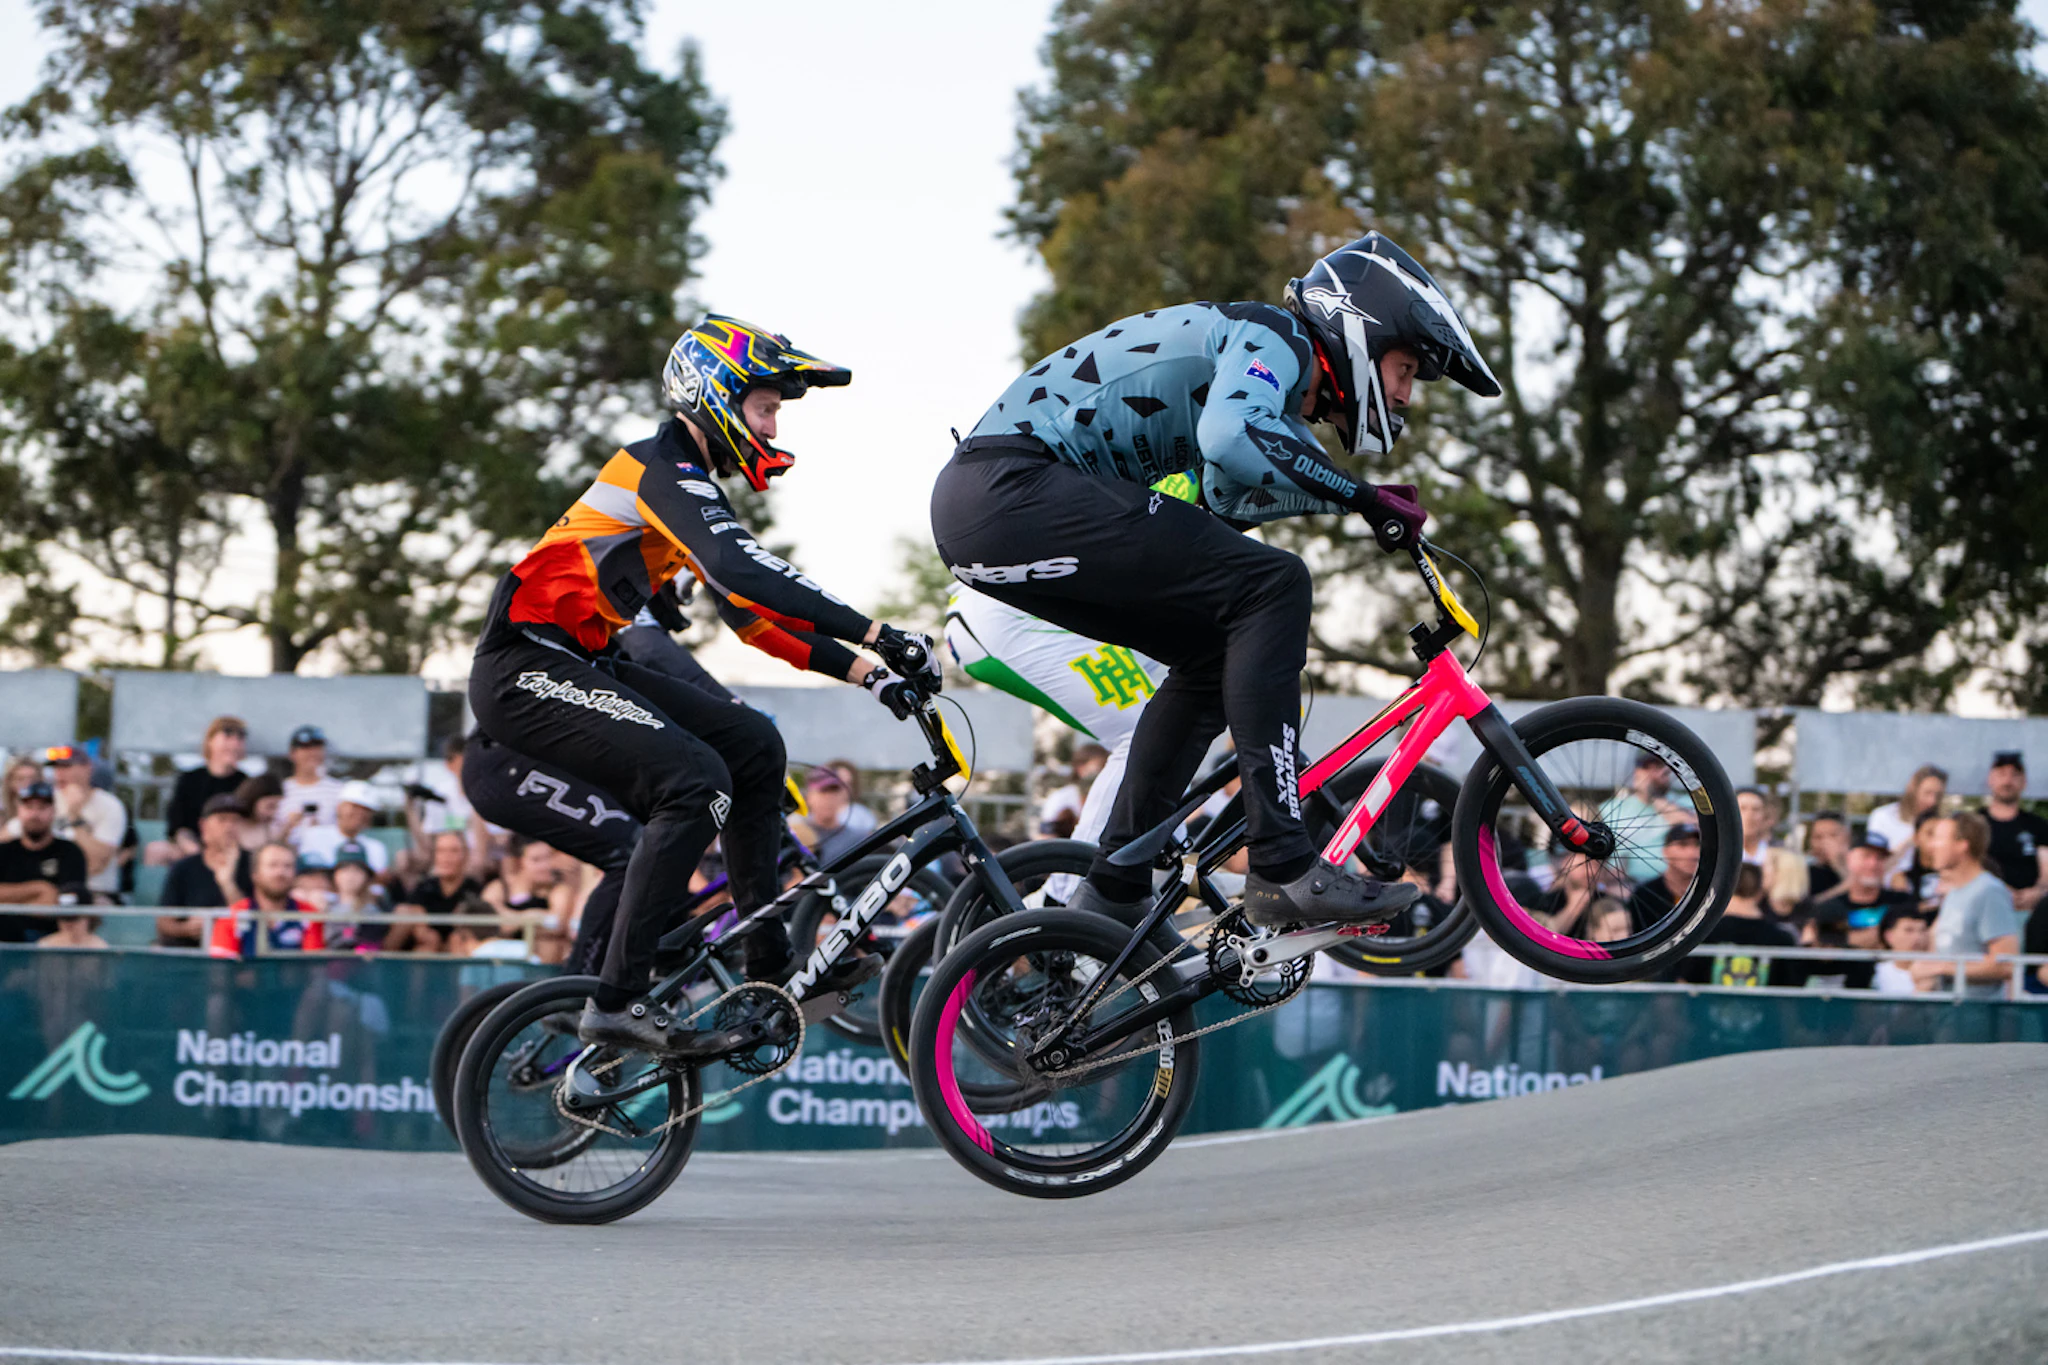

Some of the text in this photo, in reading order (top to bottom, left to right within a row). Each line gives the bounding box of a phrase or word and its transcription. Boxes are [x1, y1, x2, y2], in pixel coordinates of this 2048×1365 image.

[516, 671, 665, 730] Troy Lee Designs
[516, 769, 631, 827] FLY
[1269, 744, 1288, 804] BMX
[783, 852, 912, 1000] MEYBO
[176, 1029, 342, 1067] National
[771, 1048, 911, 1085] Nation
[173, 1069, 440, 1121] Championshi
